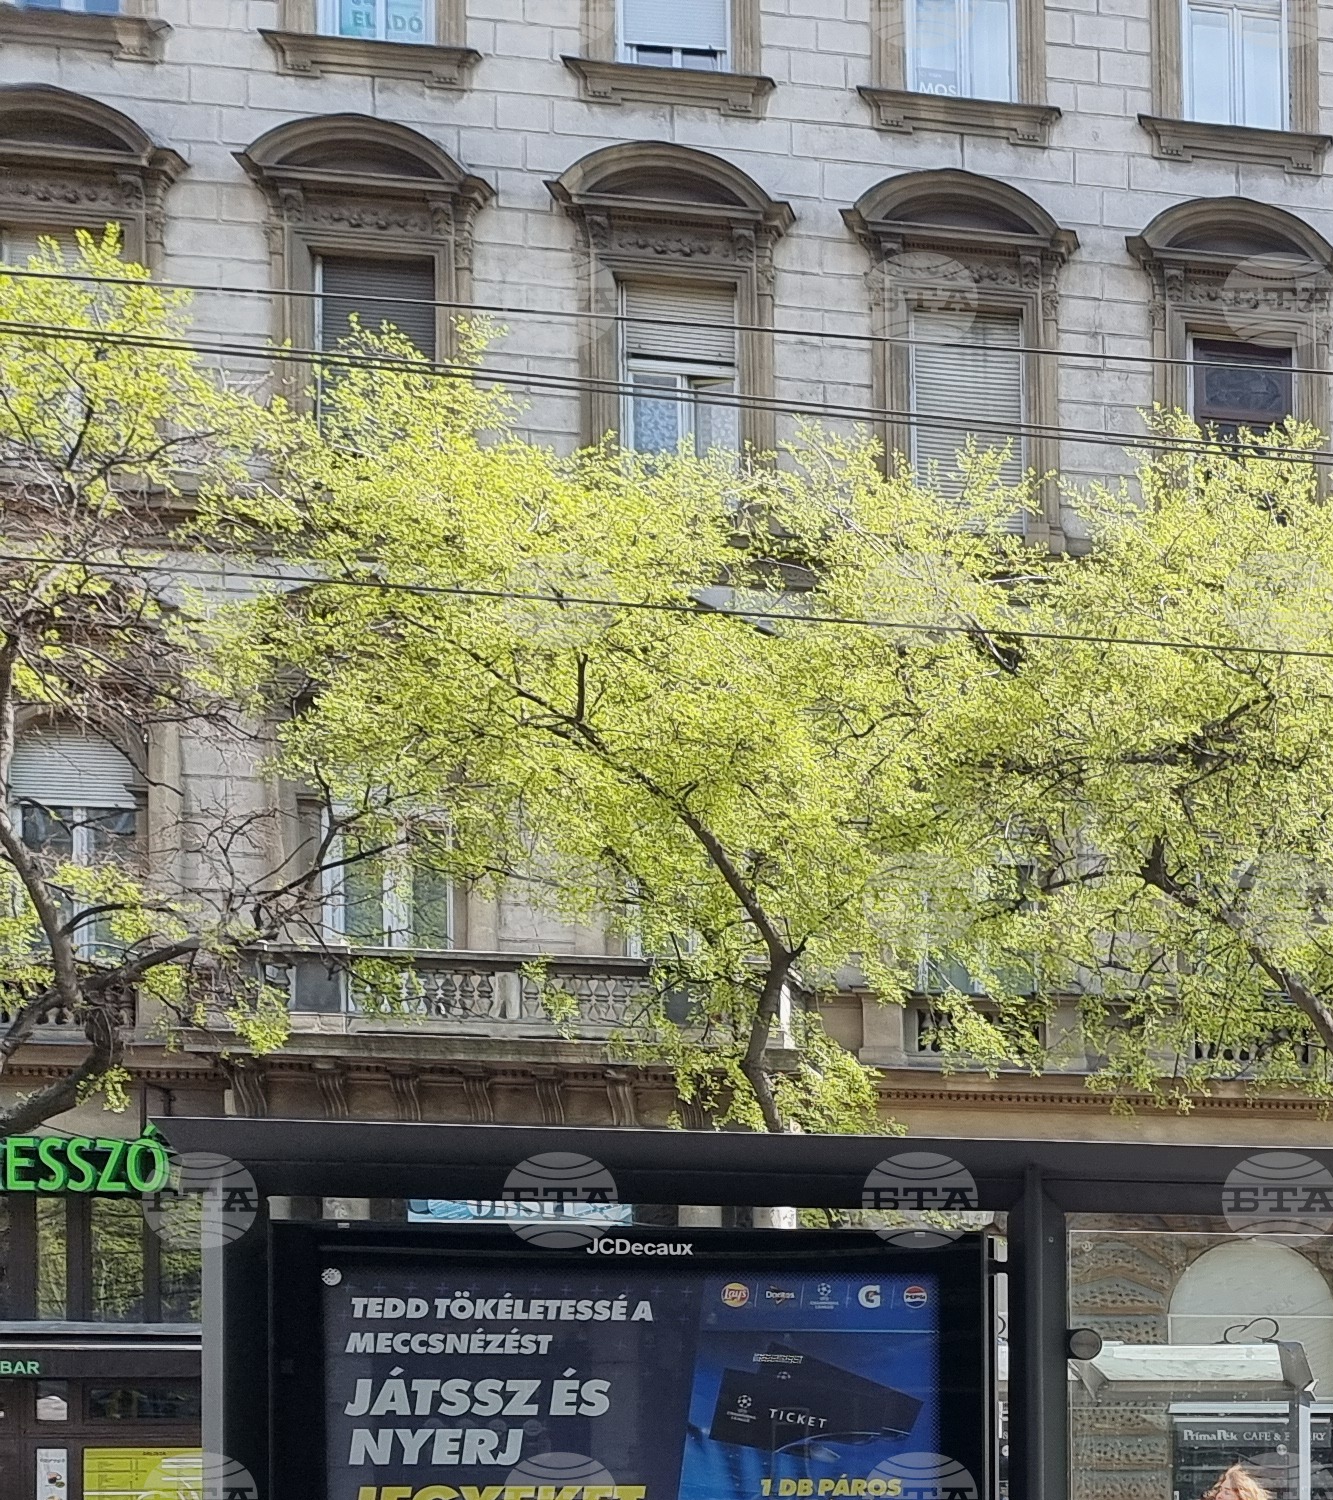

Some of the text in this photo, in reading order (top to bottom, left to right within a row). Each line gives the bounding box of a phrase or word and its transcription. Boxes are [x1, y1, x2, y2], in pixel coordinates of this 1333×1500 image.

[352, 10, 423, 33] ELDÓ
[586, 1238, 693, 1256] JCDecaux
[351, 1290, 654, 1321] TEDD TÖKÉLETESSÉ A
[345, 1327, 553, 1354] MECCSNÉZÉST
[344, 1366, 611, 1417] JÁTSSZ ÉS
[769, 1408, 828, 1429] TICKET
[348, 1428, 524, 1465] NYERJ
[761, 1474, 902, 1497] 1 DB PÁROS
